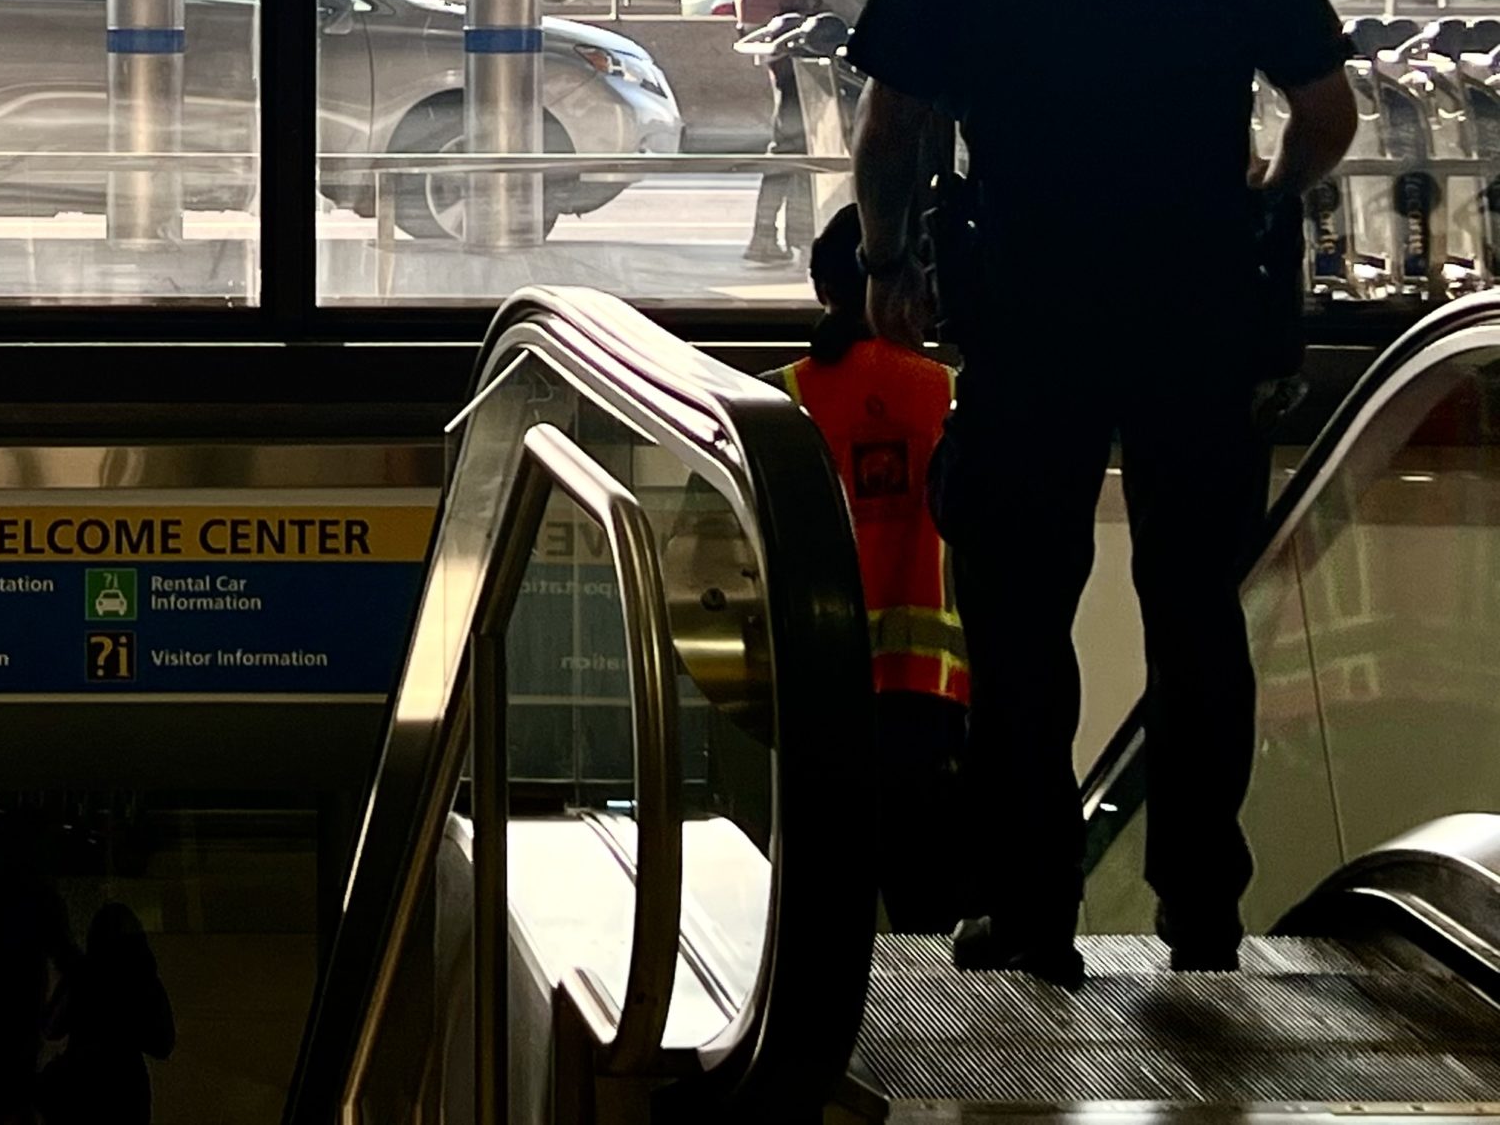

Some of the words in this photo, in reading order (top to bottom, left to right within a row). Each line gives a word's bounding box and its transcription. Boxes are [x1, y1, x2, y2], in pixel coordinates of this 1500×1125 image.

[198, 518, 371, 556] CENTER
[150, 575, 211, 593] Rental
[216, 575, 248, 593] Car
[150, 594, 262, 611] Information
[150, 649, 213, 668] Visitor
[217, 649, 329, 668] Information
